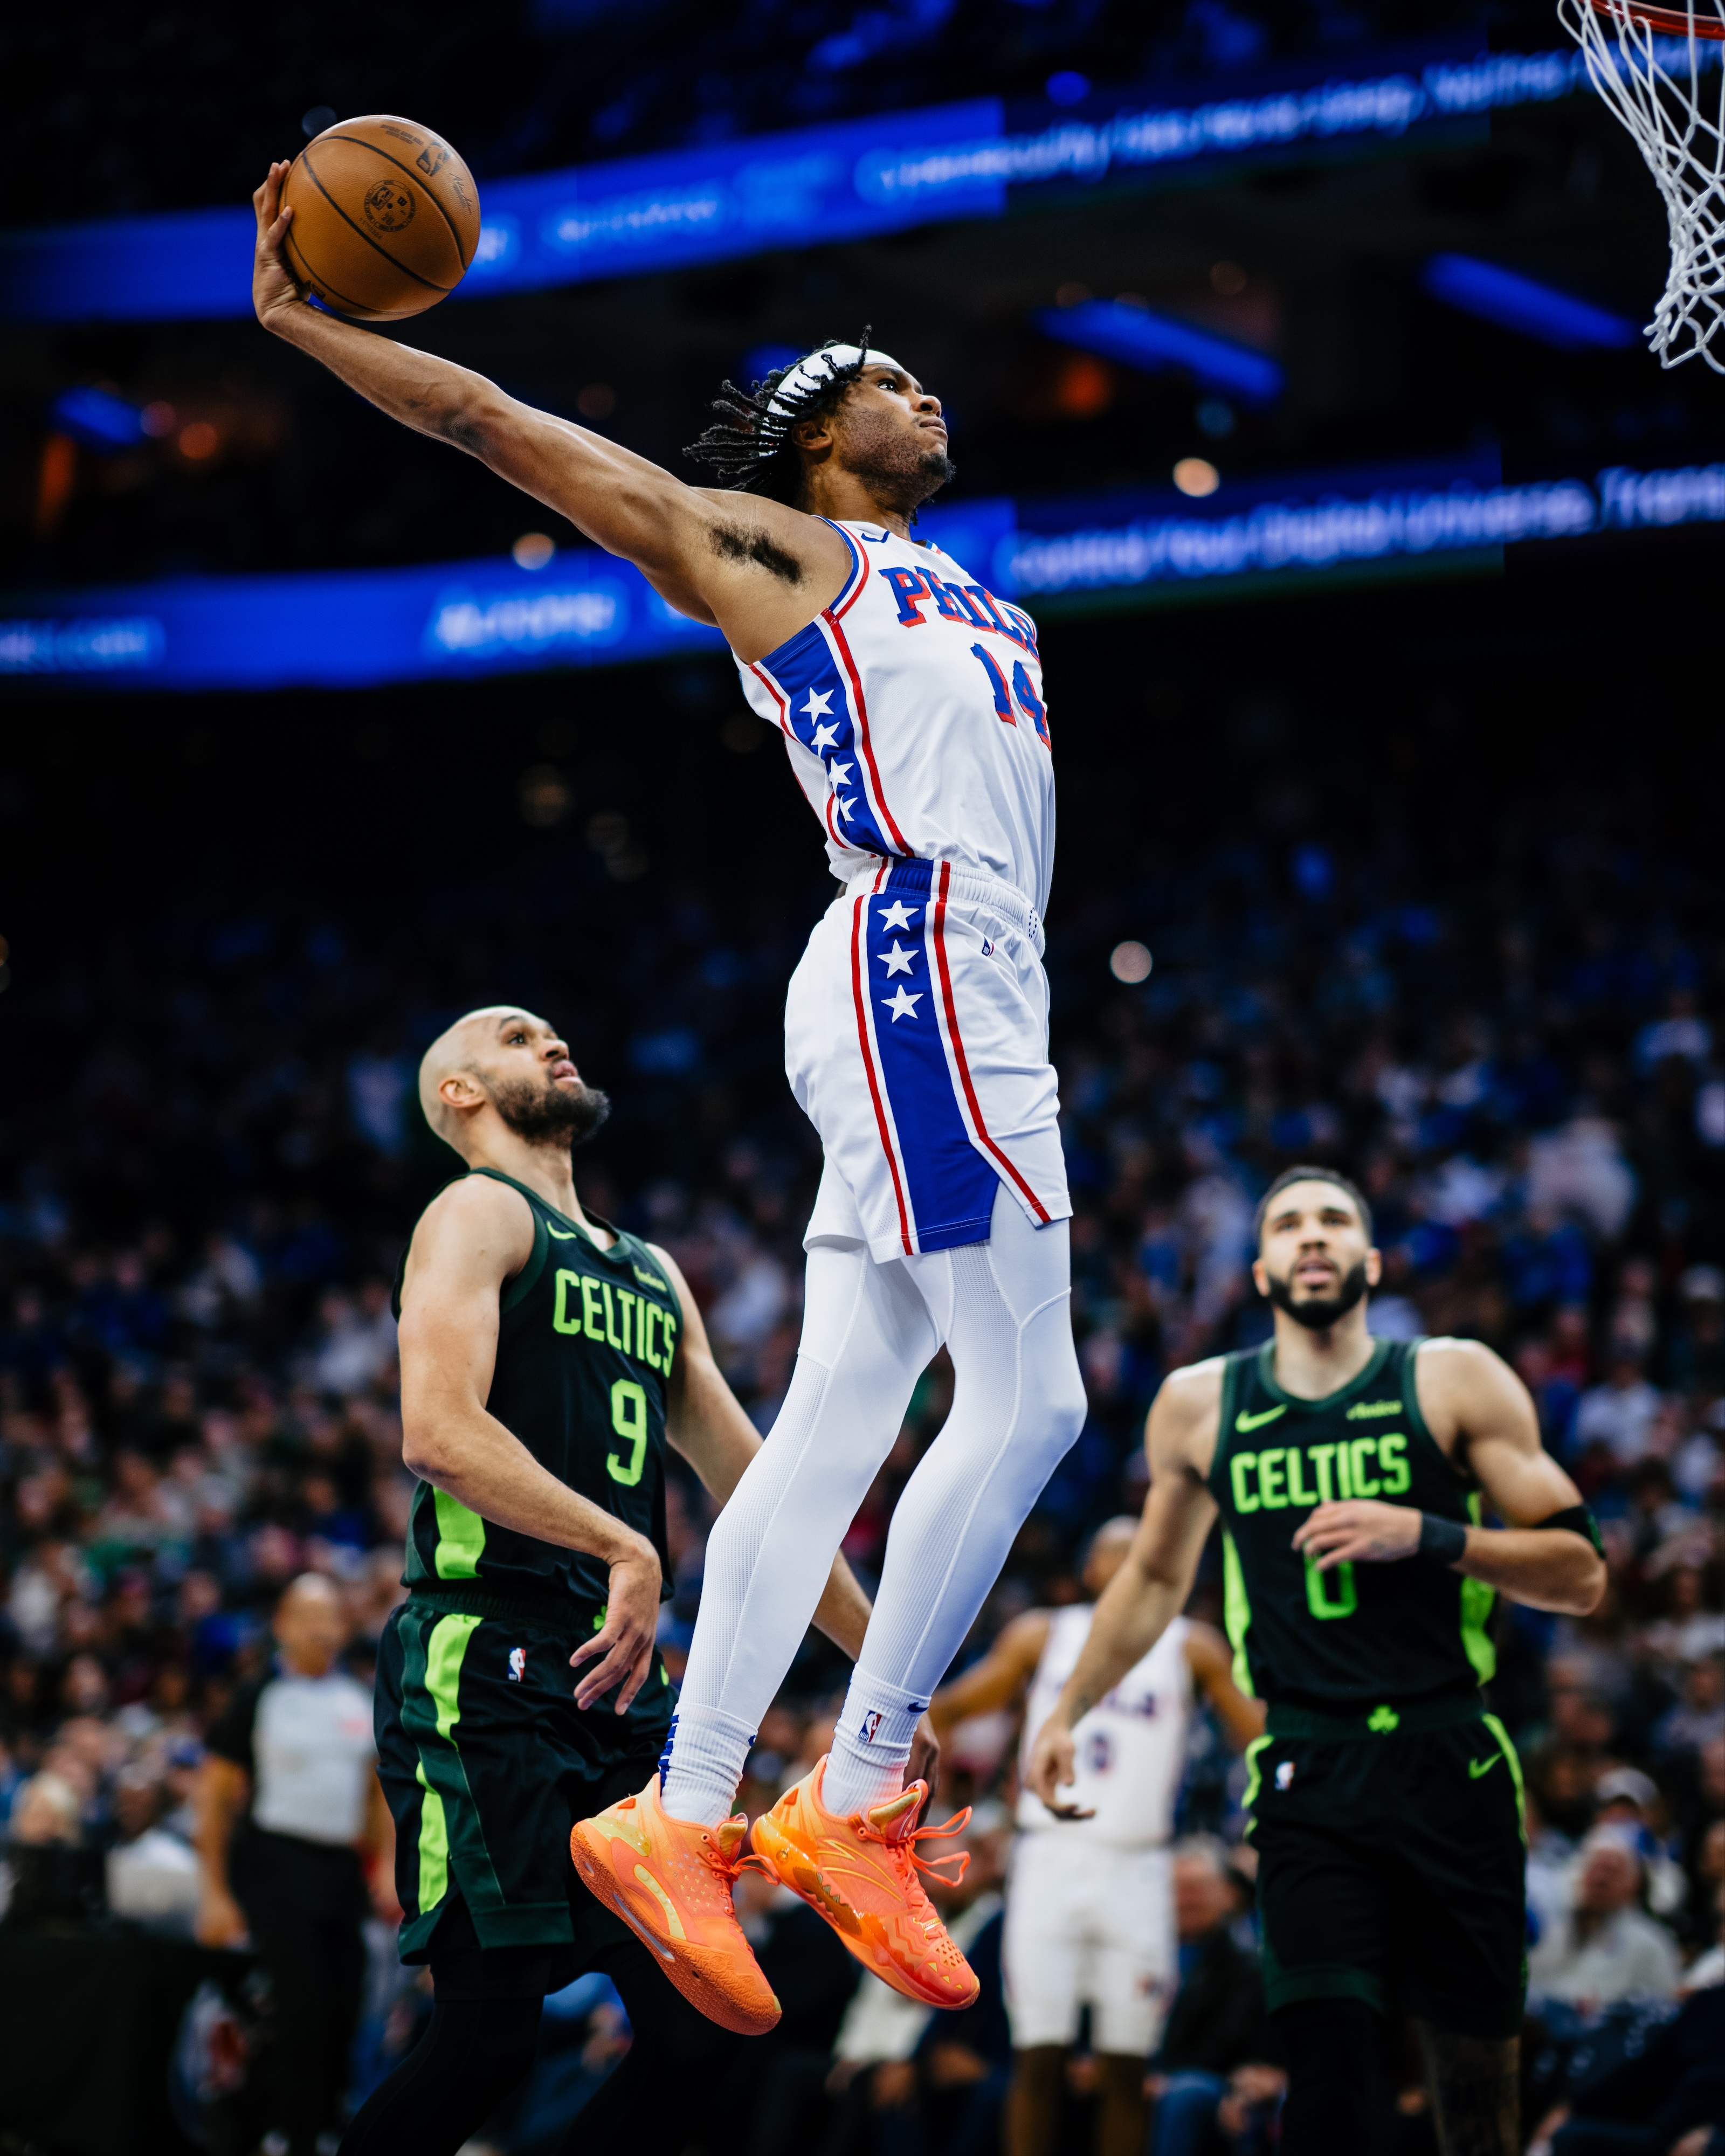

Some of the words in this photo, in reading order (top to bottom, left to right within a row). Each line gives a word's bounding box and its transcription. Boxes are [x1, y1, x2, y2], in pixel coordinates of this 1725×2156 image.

[970, 642, 1051, 752] 14
[553, 1268, 677, 1378] CELTICS
[606, 1378, 647, 1487] 9
[1230, 1432, 1412, 1515] CELTICS
